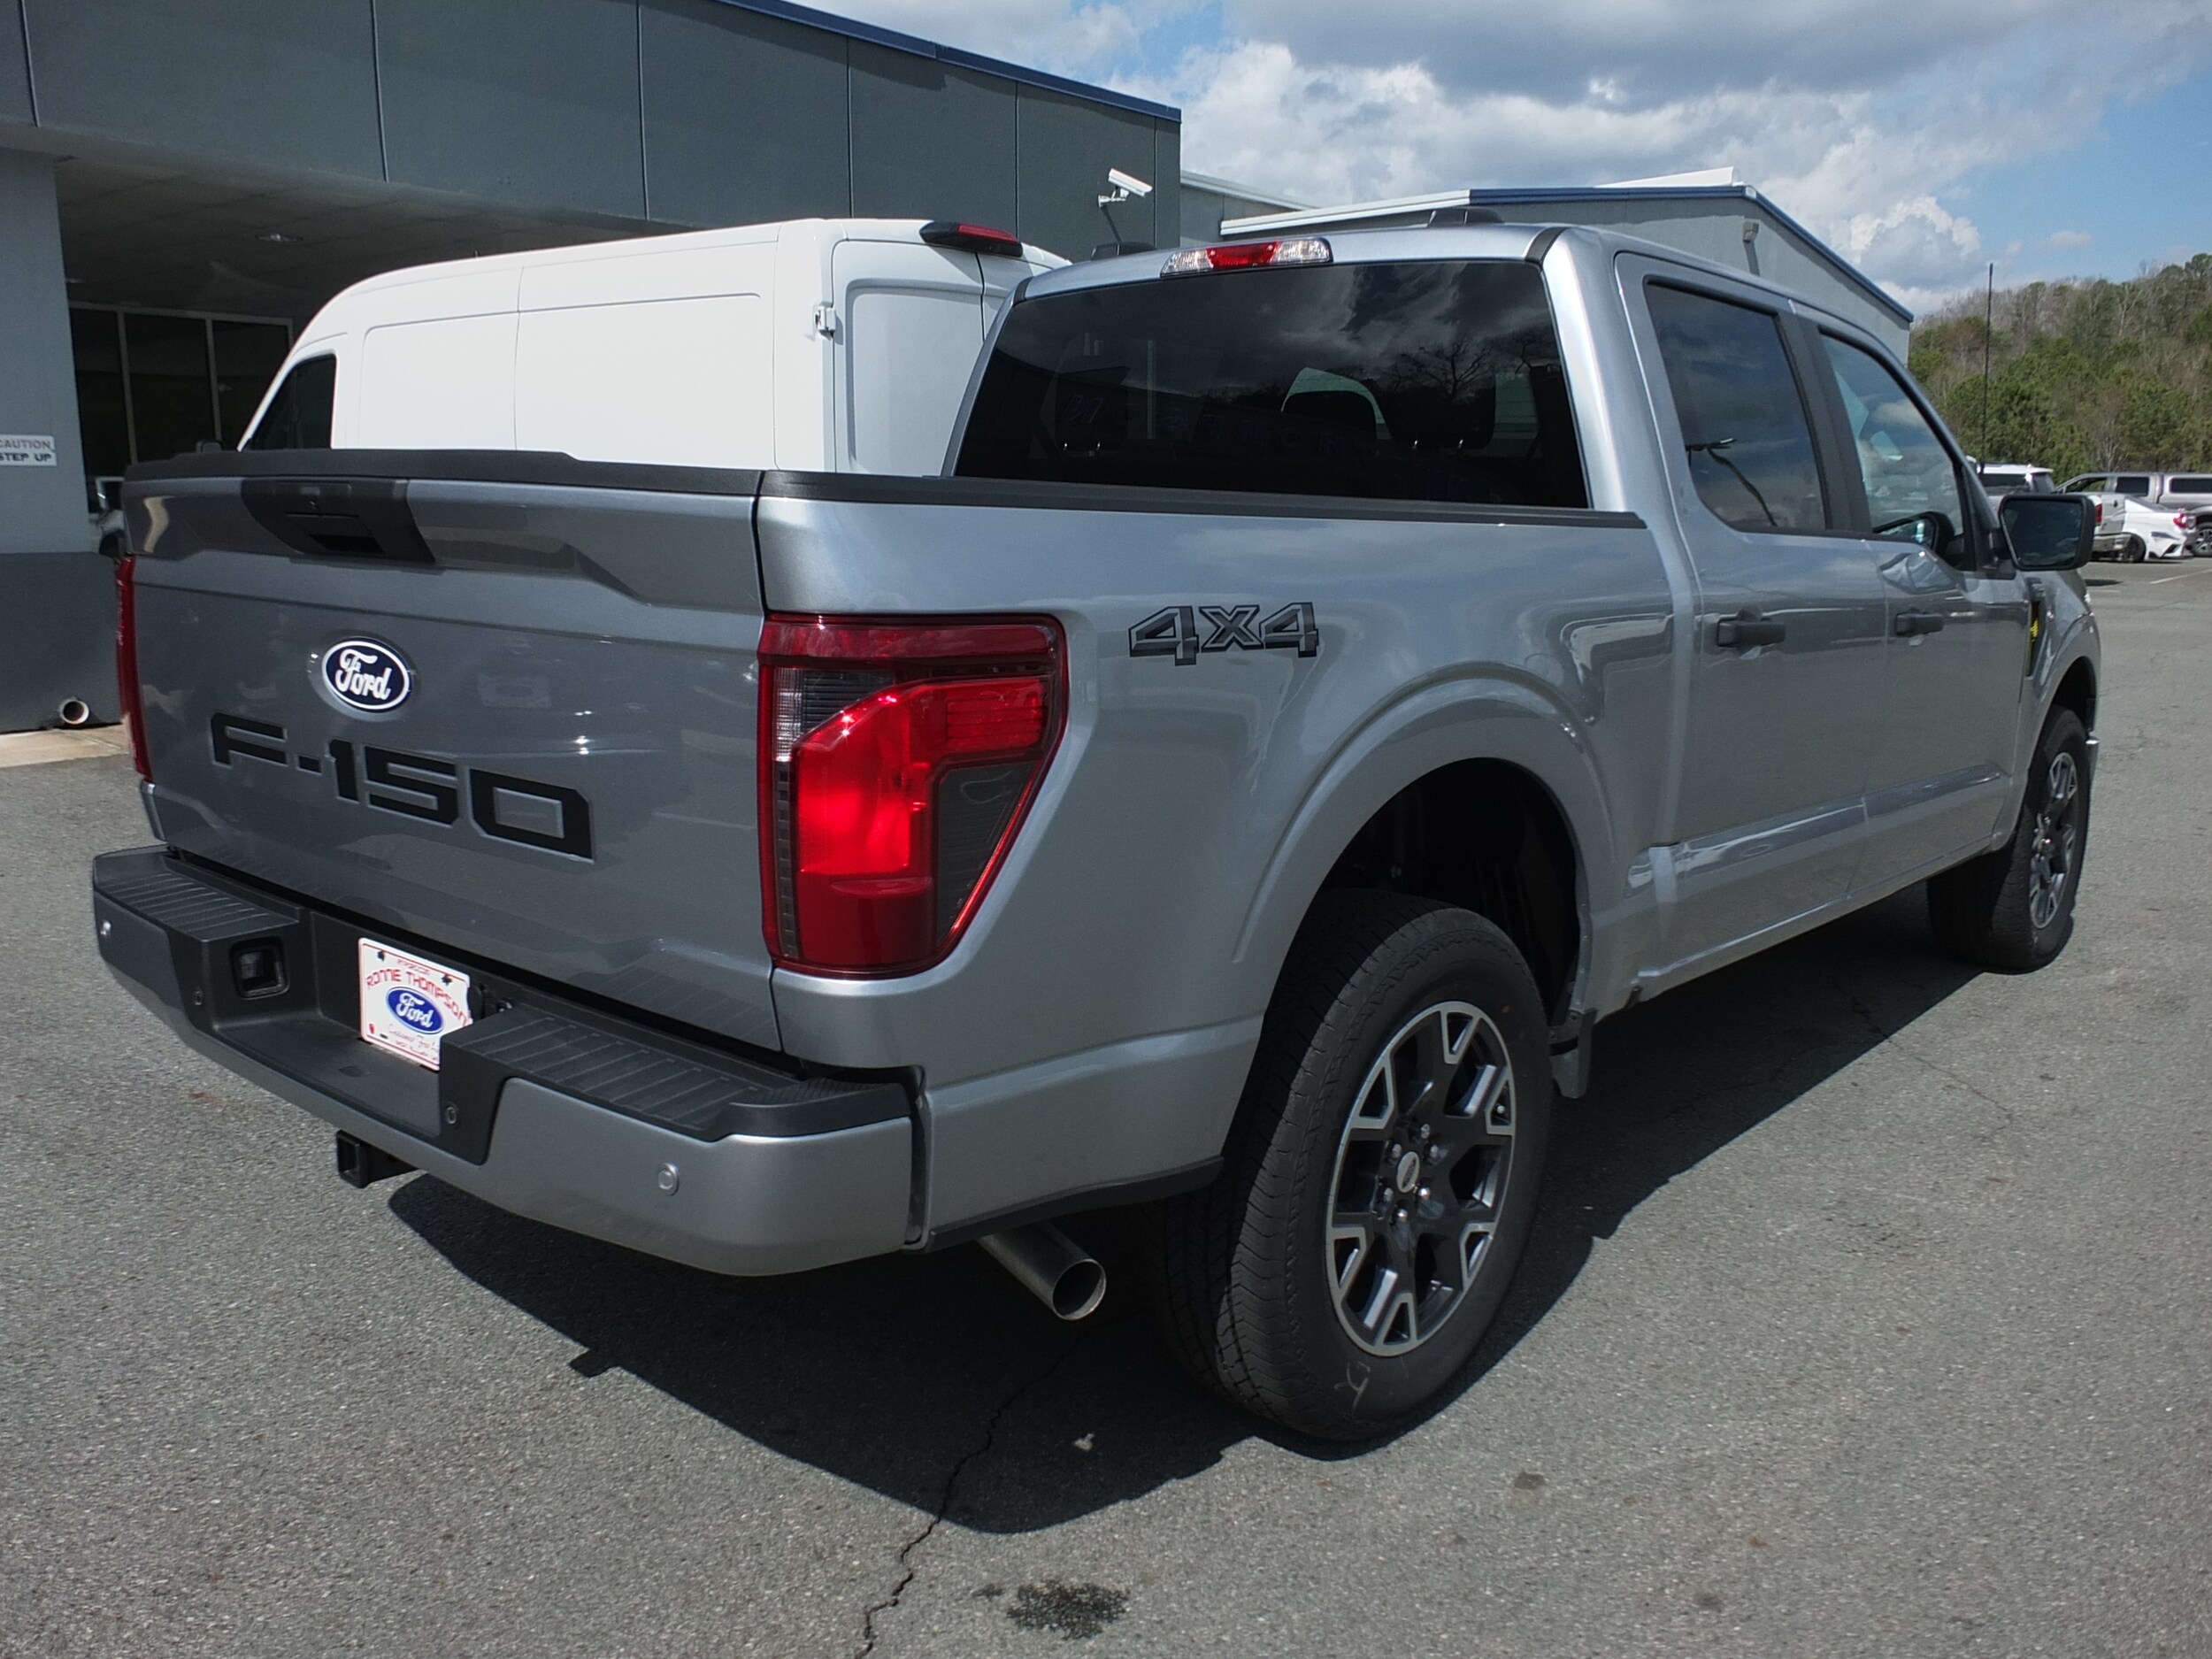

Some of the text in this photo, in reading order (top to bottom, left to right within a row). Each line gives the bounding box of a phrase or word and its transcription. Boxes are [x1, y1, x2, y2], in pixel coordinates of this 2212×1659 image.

[35, 453, 52, 462] UP
[1128, 602, 1319, 666] 4X4
[334, 649, 392, 702] Ford
[211, 712, 595, 864] F-150
[396, 992, 434, 1028] Ford
